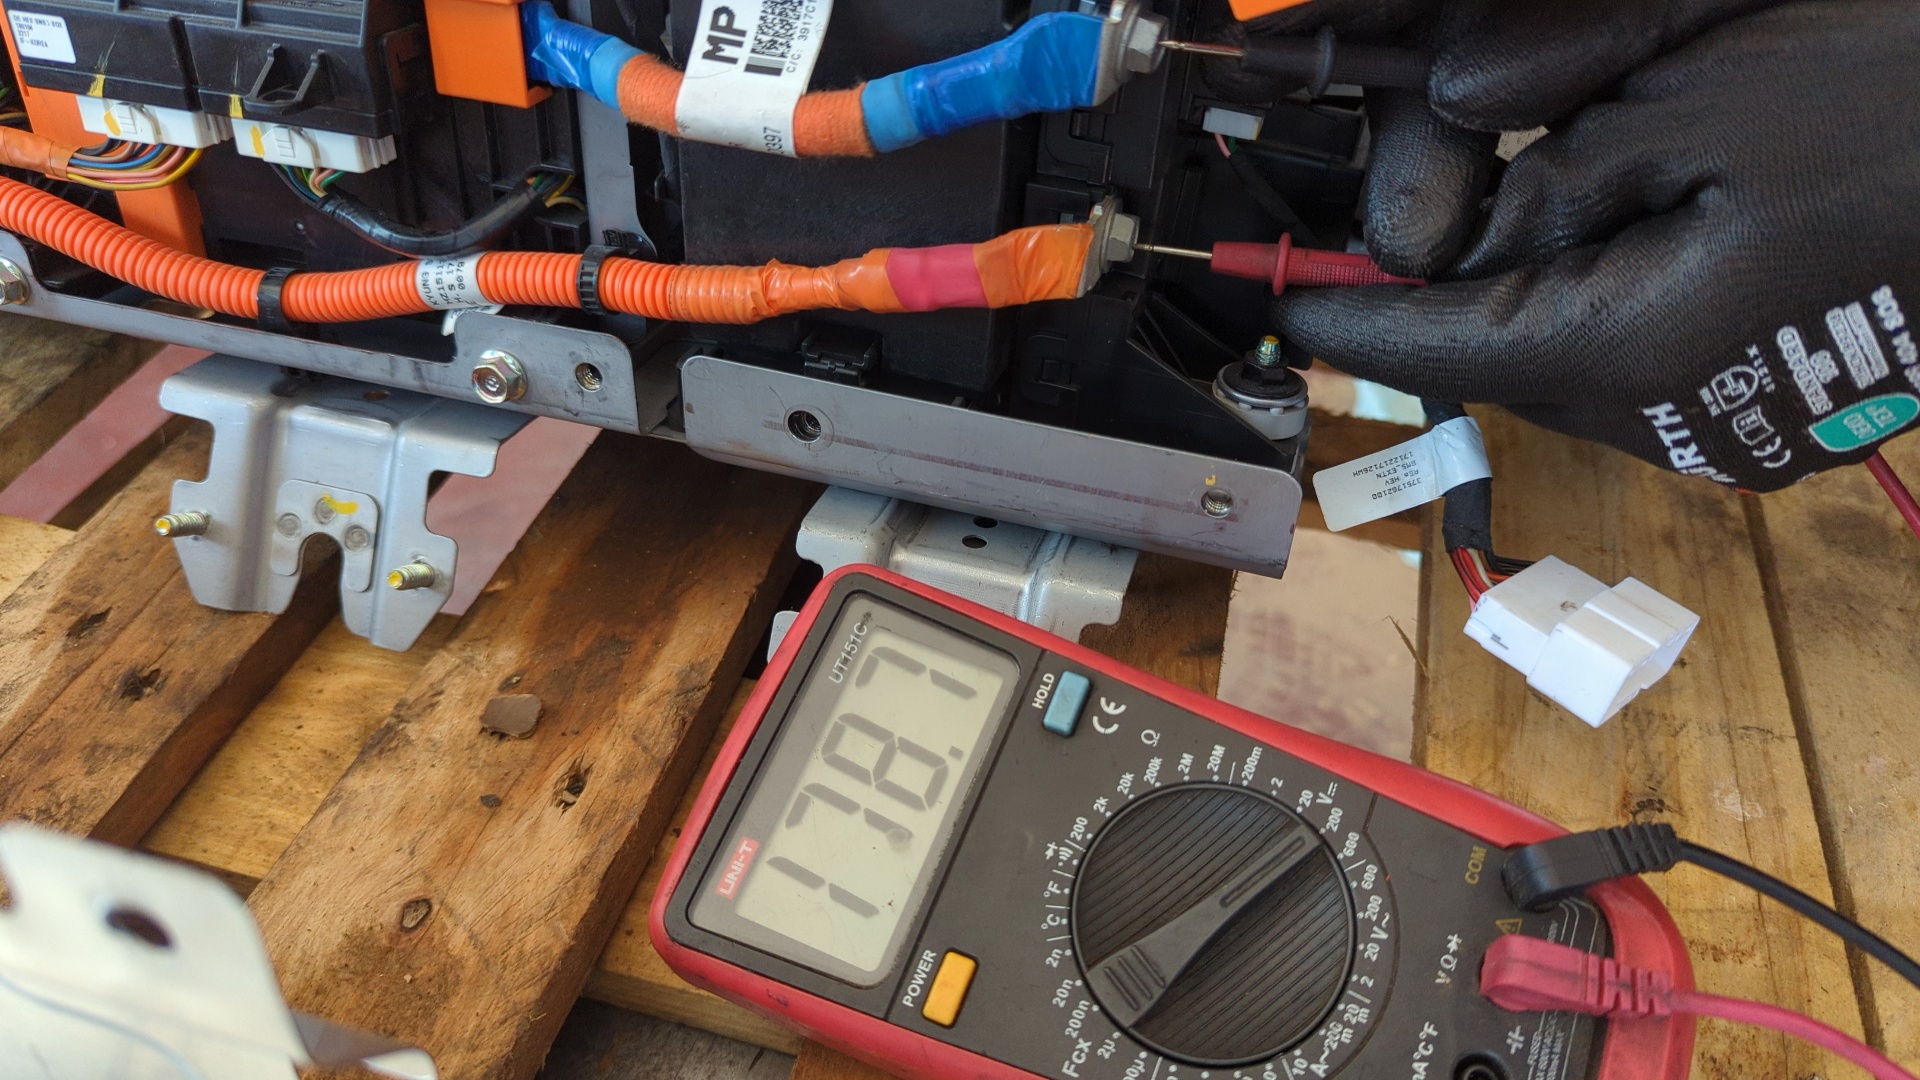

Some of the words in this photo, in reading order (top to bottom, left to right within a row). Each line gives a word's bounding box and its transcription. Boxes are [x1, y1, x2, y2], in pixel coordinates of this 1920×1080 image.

[701, 5, 748, 65] MP
[423, 272, 439, 305] KYUNG
[1776, 326, 1833, 415] STANDARD
[1809, 350, 1840, 384] 100
[1384, 477, 1400, 486] HEV
[829, 622, 868, 685] UT151C
[1032, 673, 1055, 709] HOLD
[1144, 757, 1163, 783] 200k
[1178, 753, 1194, 774] 2M
[1207, 744, 1226, 774] 20M
[1242, 746, 1263, 780] 200m
[1117, 771, 1134, 795] 20k
[1271, 777, 1284, 789] 2
[1093, 796, 1109, 813] 2k
[1299, 790, 1313, 807] 20
[1070, 817, 1088, 841] 200
[1326, 807, 1343, 832] 200
[1343, 831, 1359, 857] 600
[720, 838, 755, 897] UNI-T
[1361, 864, 1378, 890] 600
[1464, 846, 1487, 885] COM
[1364, 895, 1383, 922] 200
[1046, 949, 1062, 967] 2n
[1364, 943, 1380, 962] 20
[902, 949, 937, 1007] POWER
[1360, 976, 1374, 988] 2
[1053, 979, 1073, 1007] 20n
[1065, 1000, 1090, 1038] 200n
[1292, 1058, 1308, 1076] 10
